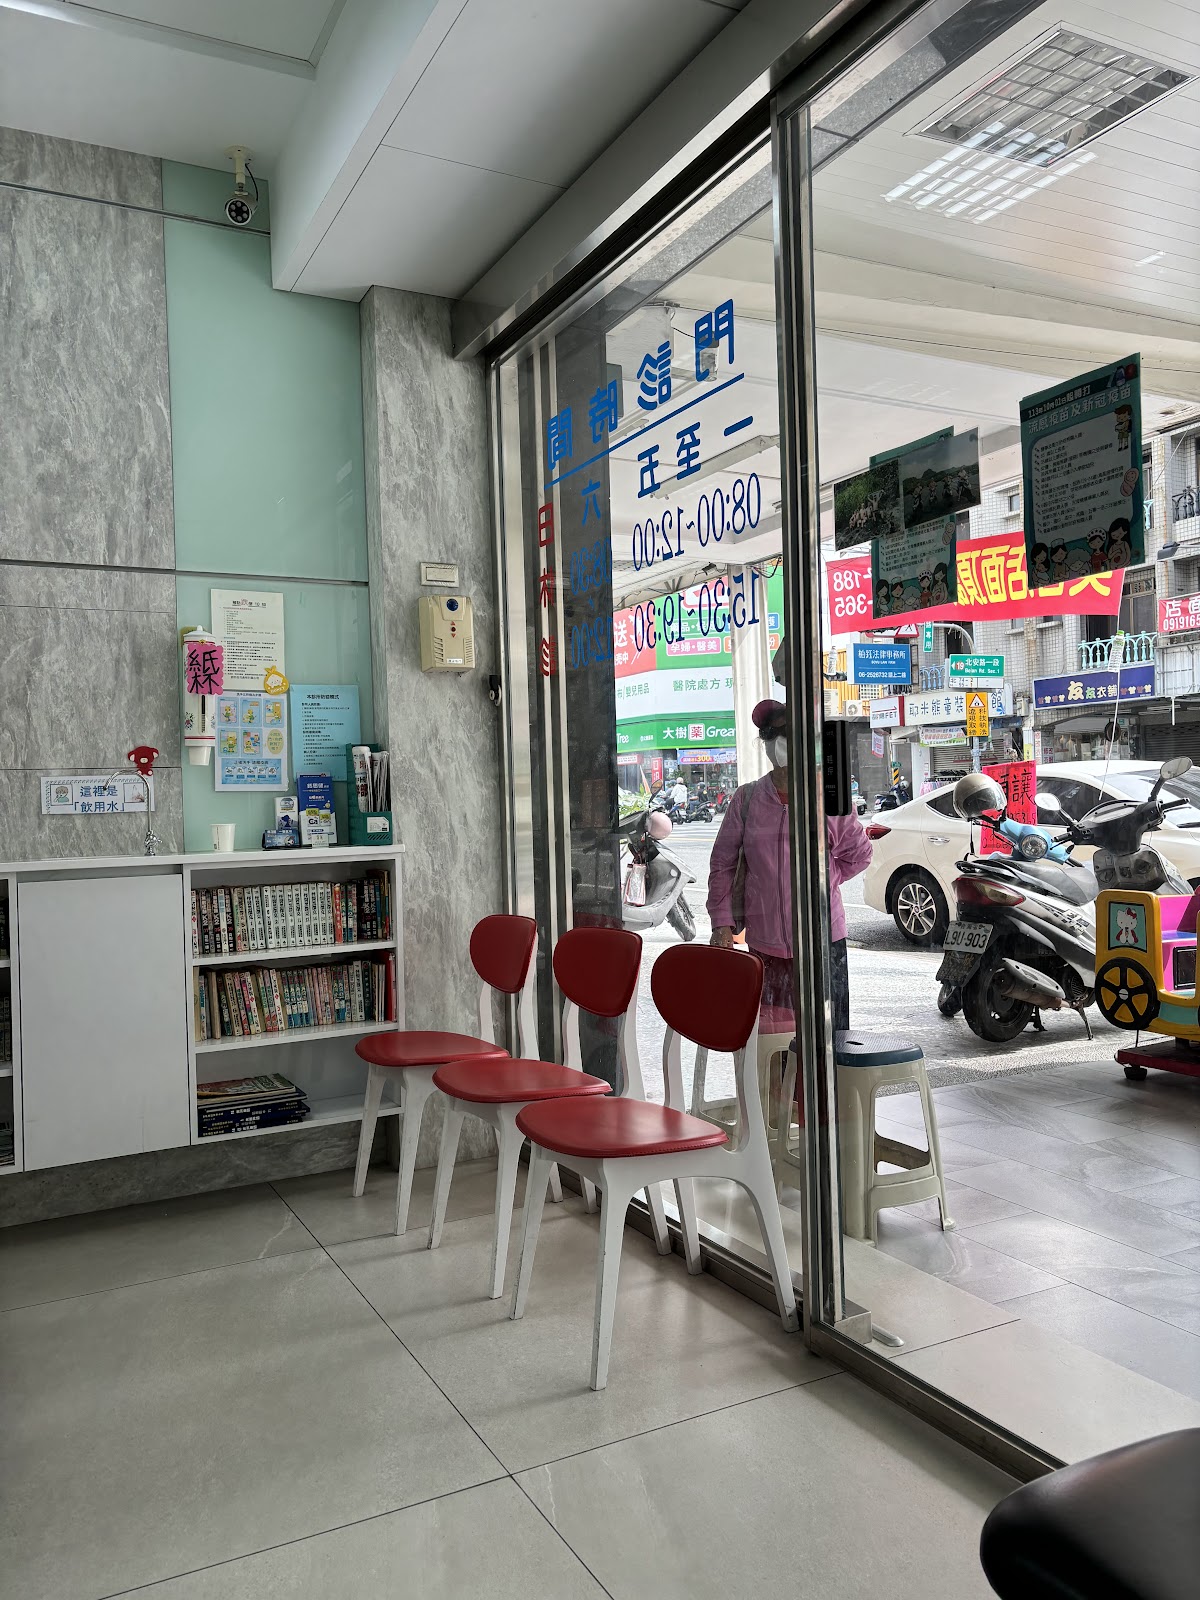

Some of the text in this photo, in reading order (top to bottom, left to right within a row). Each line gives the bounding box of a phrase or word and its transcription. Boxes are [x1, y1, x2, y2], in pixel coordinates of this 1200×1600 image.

[1028, 381, 1131, 434] 流感疫苗及新冠疫苗
[956, 661, 965, 670] 19
[965, 658, 1000, 666] 北安路一段
[188, 649, 220, 694] 紙杯
[673, 677, 721, 690] 醫院處方
[662, 727, 688, 739] 大樹
[706, 726, 736, 738] Grea
[80, 785, 118, 798] 這裡是
